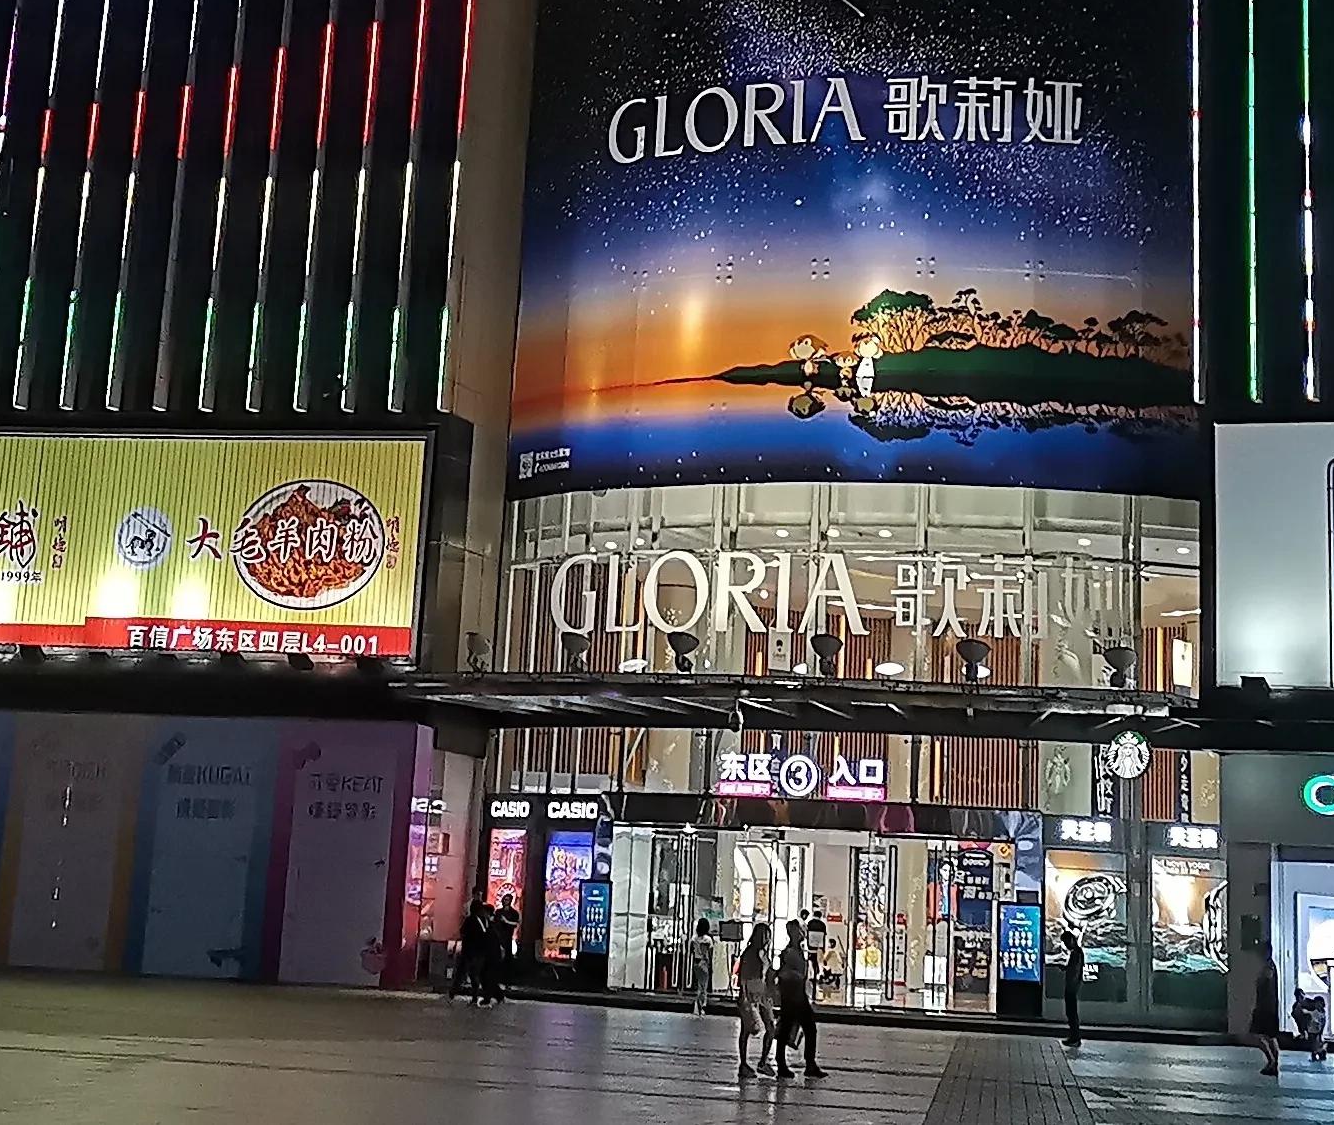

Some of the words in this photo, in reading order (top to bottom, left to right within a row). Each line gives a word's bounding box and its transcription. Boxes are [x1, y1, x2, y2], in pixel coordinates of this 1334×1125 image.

[607, 77, 866, 164] GLORIA
[883, 75, 1084, 145] 歌莉娅
[185, 516, 379, 564] 大毛羊肉粉
[1, 570, 42, 582] 1999年
[550, 550, 868, 637] GLORIA
[127, 625, 379, 656] 百信广场东区四层L4-001
[720, 751, 773, 781] 东区
[829, 754, 885, 786] 入口
[490, 800, 531, 819] CASIO
[547, 801, 599, 819] CASIO
